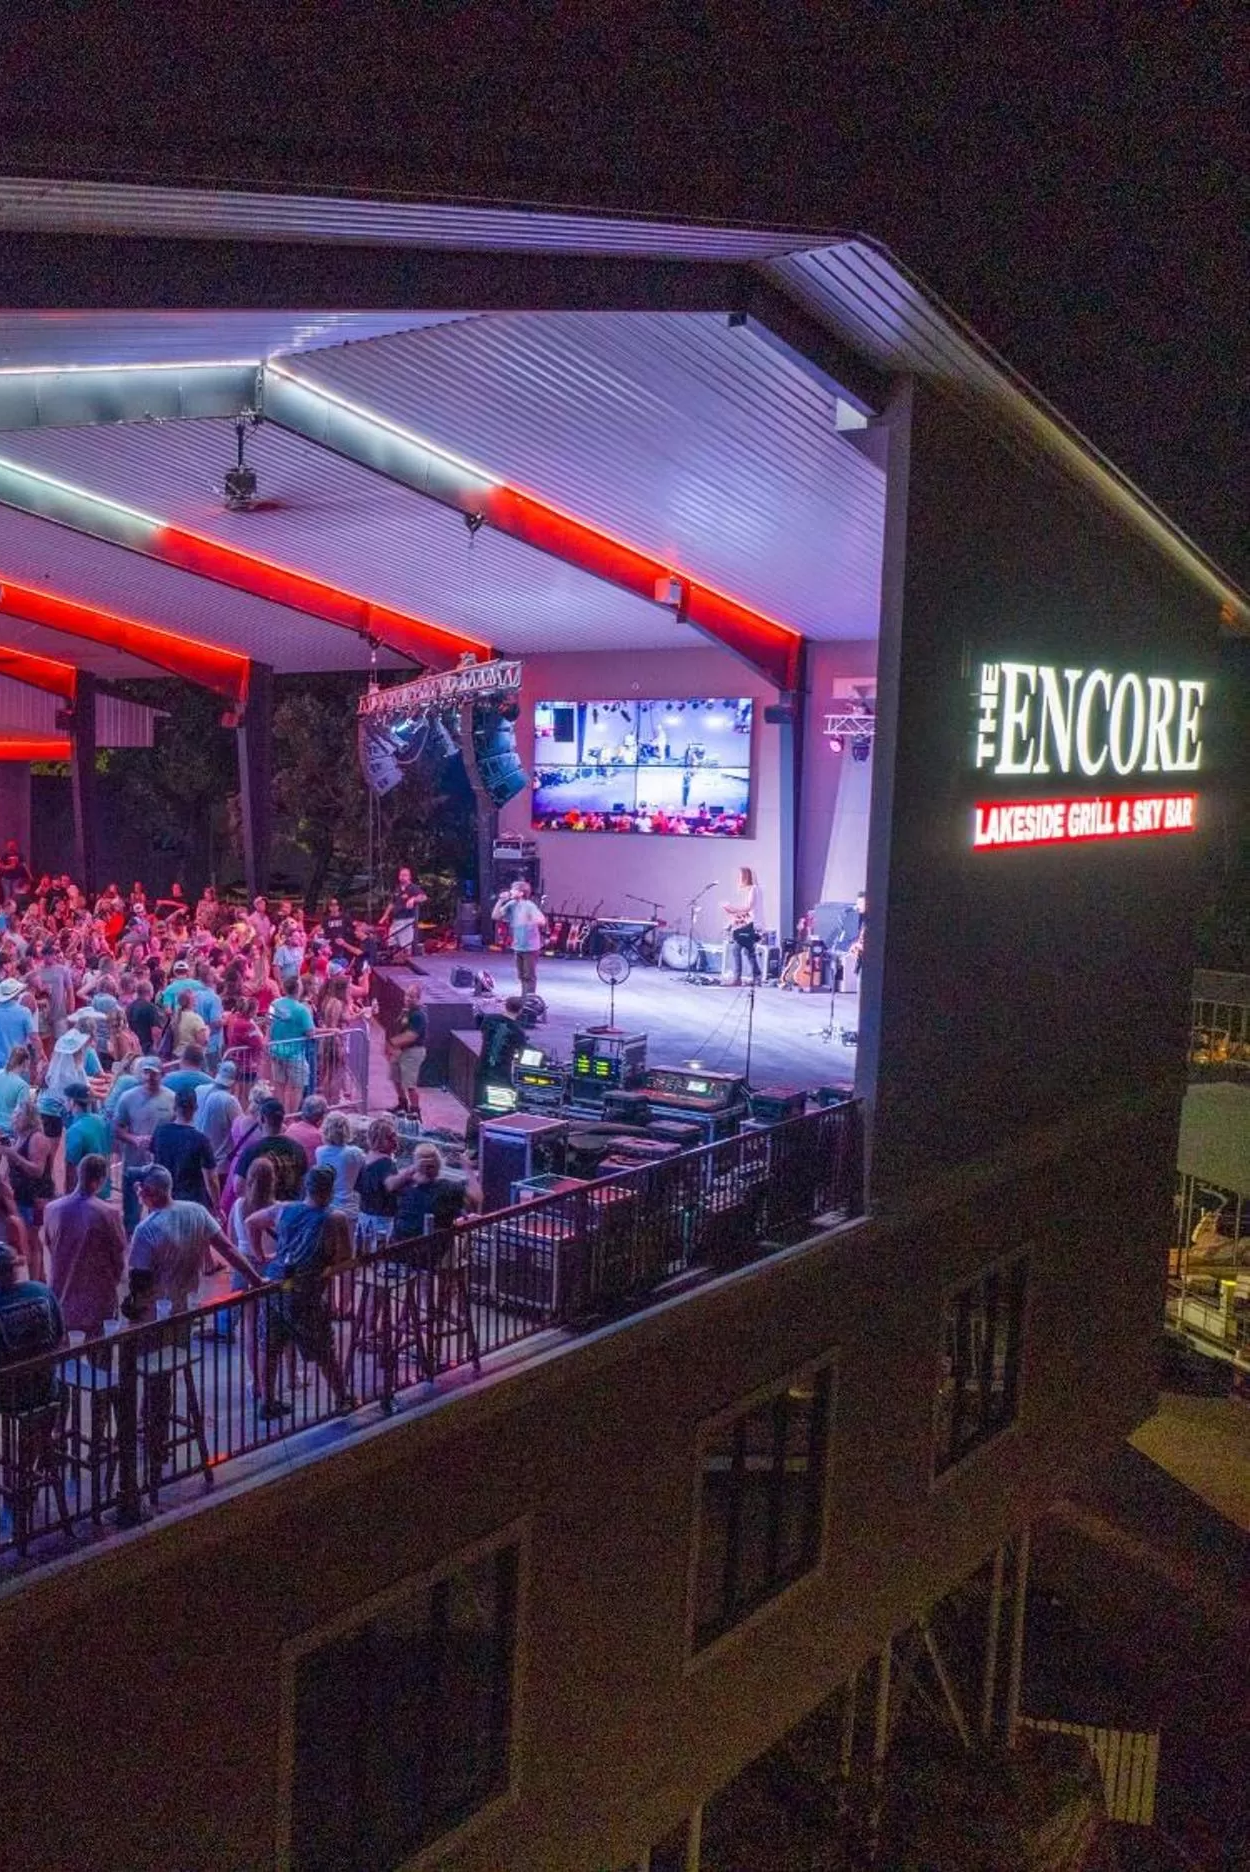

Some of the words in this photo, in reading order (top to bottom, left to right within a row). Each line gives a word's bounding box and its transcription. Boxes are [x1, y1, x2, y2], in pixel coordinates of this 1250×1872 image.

[976, 663, 999, 768] THE
[994, 662, 1205, 776] ENCORE
[974, 805, 1065, 845] LAKESIDE
[1068, 801, 1114, 837] GRILL
[1117, 800, 1130, 832] &
[1132, 799, 1164, 832] SKY
[1164, 797, 1193, 829] BAR
